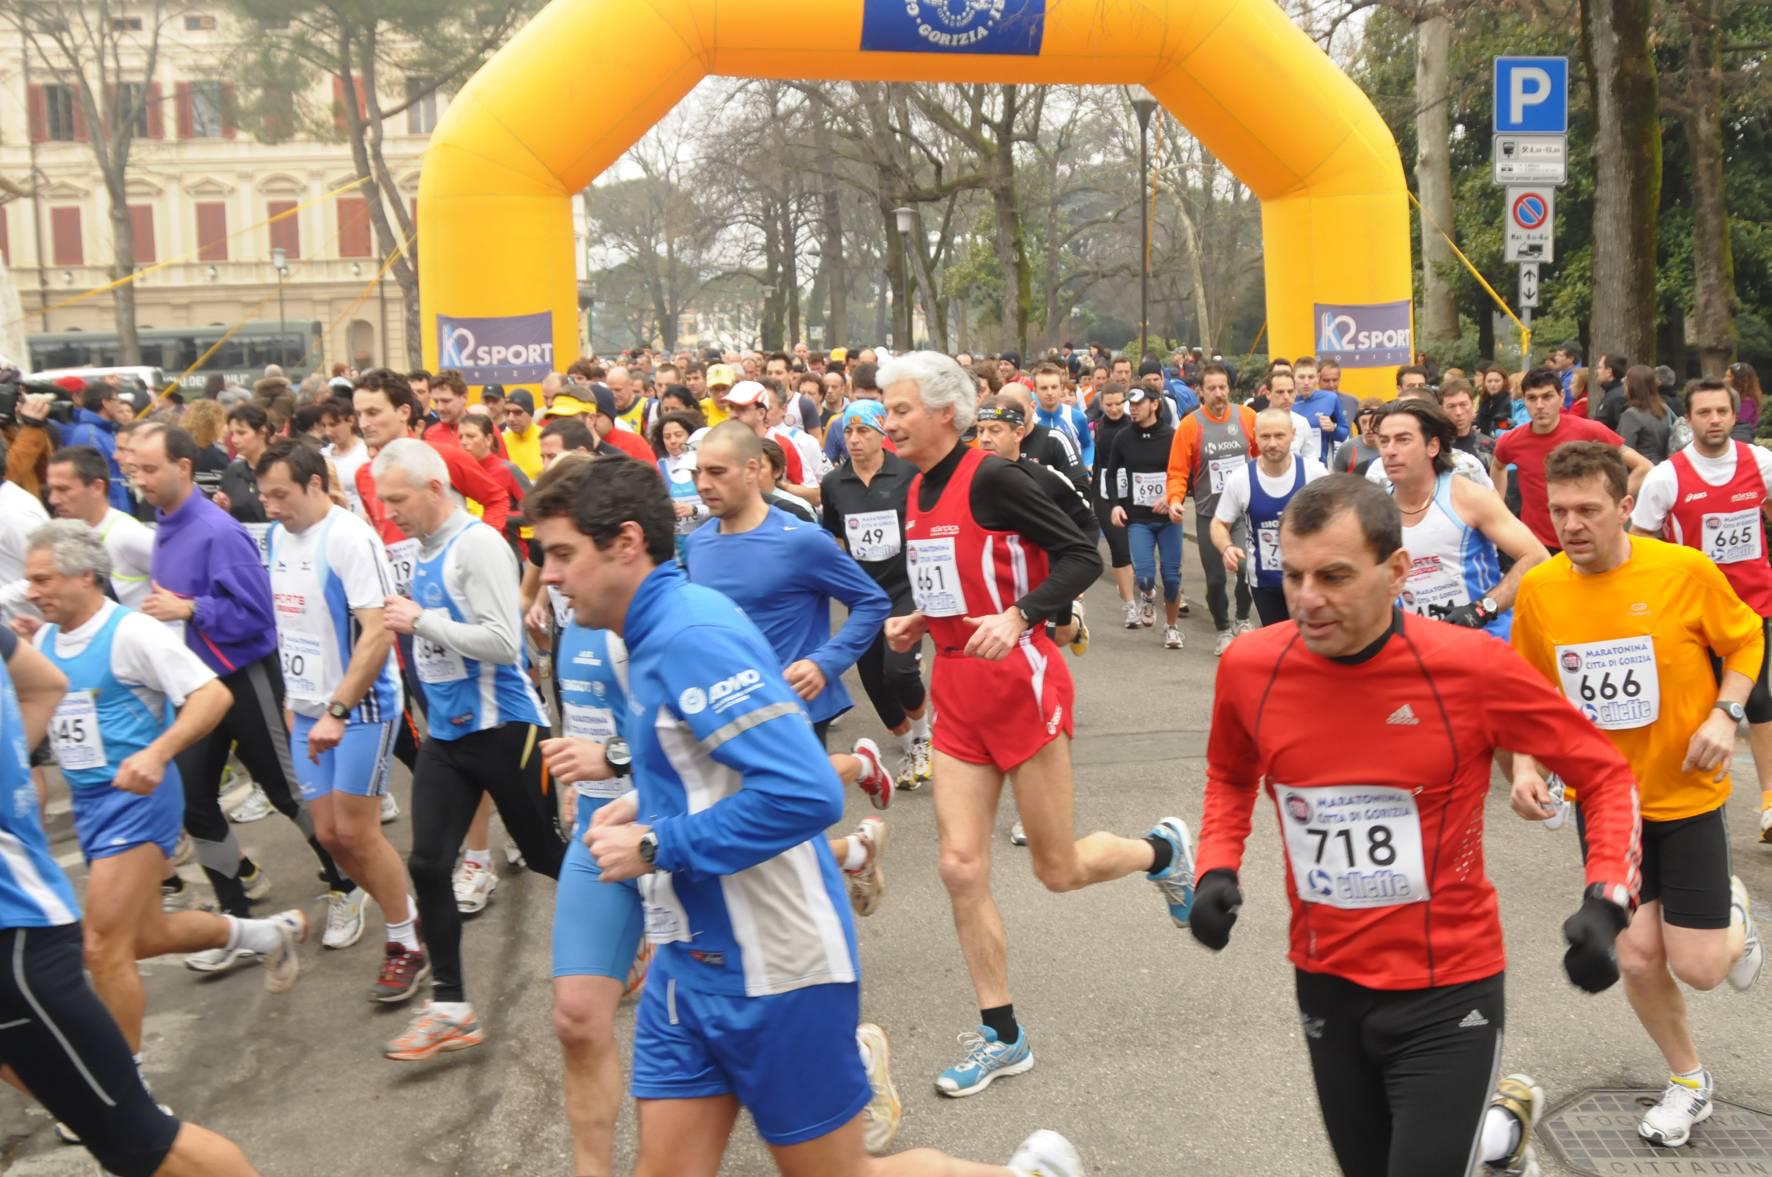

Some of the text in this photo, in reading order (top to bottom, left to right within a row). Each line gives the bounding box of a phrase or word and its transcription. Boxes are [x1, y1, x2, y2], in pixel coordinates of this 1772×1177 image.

[918, 24, 989, 46] GORIZIA
[1510, 67, 1552, 124] P
[1321, 312, 1356, 350] K2
[442, 325, 552, 367] K2 SPORT
[1218, 441, 1241, 451] KRKA
[1139, 483, 1163, 496] 690
[862, 528, 884, 545] 49
[1715, 526, 1752, 547] 665
[917, 566, 945, 591] 661
[1585, 643, 1649, 658] MARATONINA
[1585, 654, 1652, 670] CITTA DI GORIZIA
[1580, 668, 1641, 702] 666
[1317, 794, 1407, 808] MARATONINA
[1317, 806, 1412, 824] CITTA DI GORIZIA
[1306, 824, 1397, 868] 718
